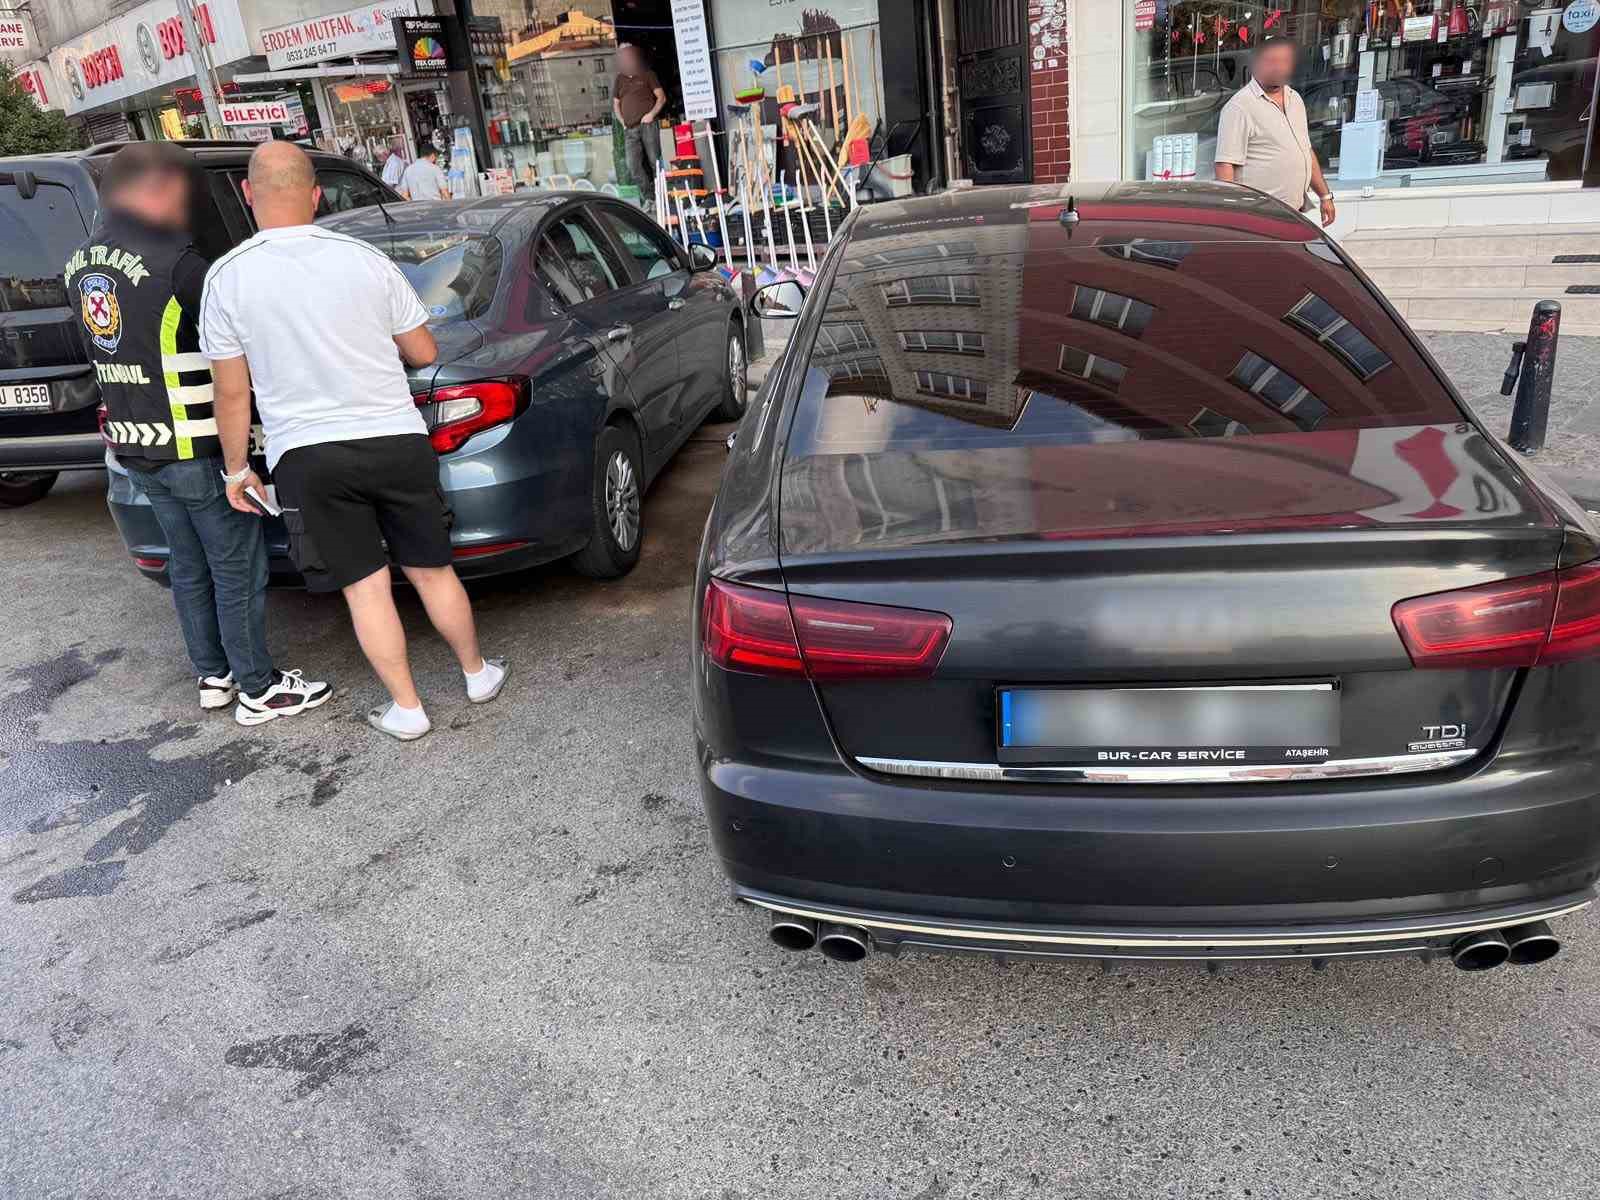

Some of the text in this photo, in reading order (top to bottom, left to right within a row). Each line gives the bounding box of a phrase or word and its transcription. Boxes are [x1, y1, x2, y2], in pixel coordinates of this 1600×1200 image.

[156, 3, 216, 60] BOSH
[262, 15, 355, 52] ERDEM MUTFAK
[0, 37, 25, 47] RVE
[14, 386, 49, 404] 8358
[1097, 751, 1171, 760] BUR-CAR
